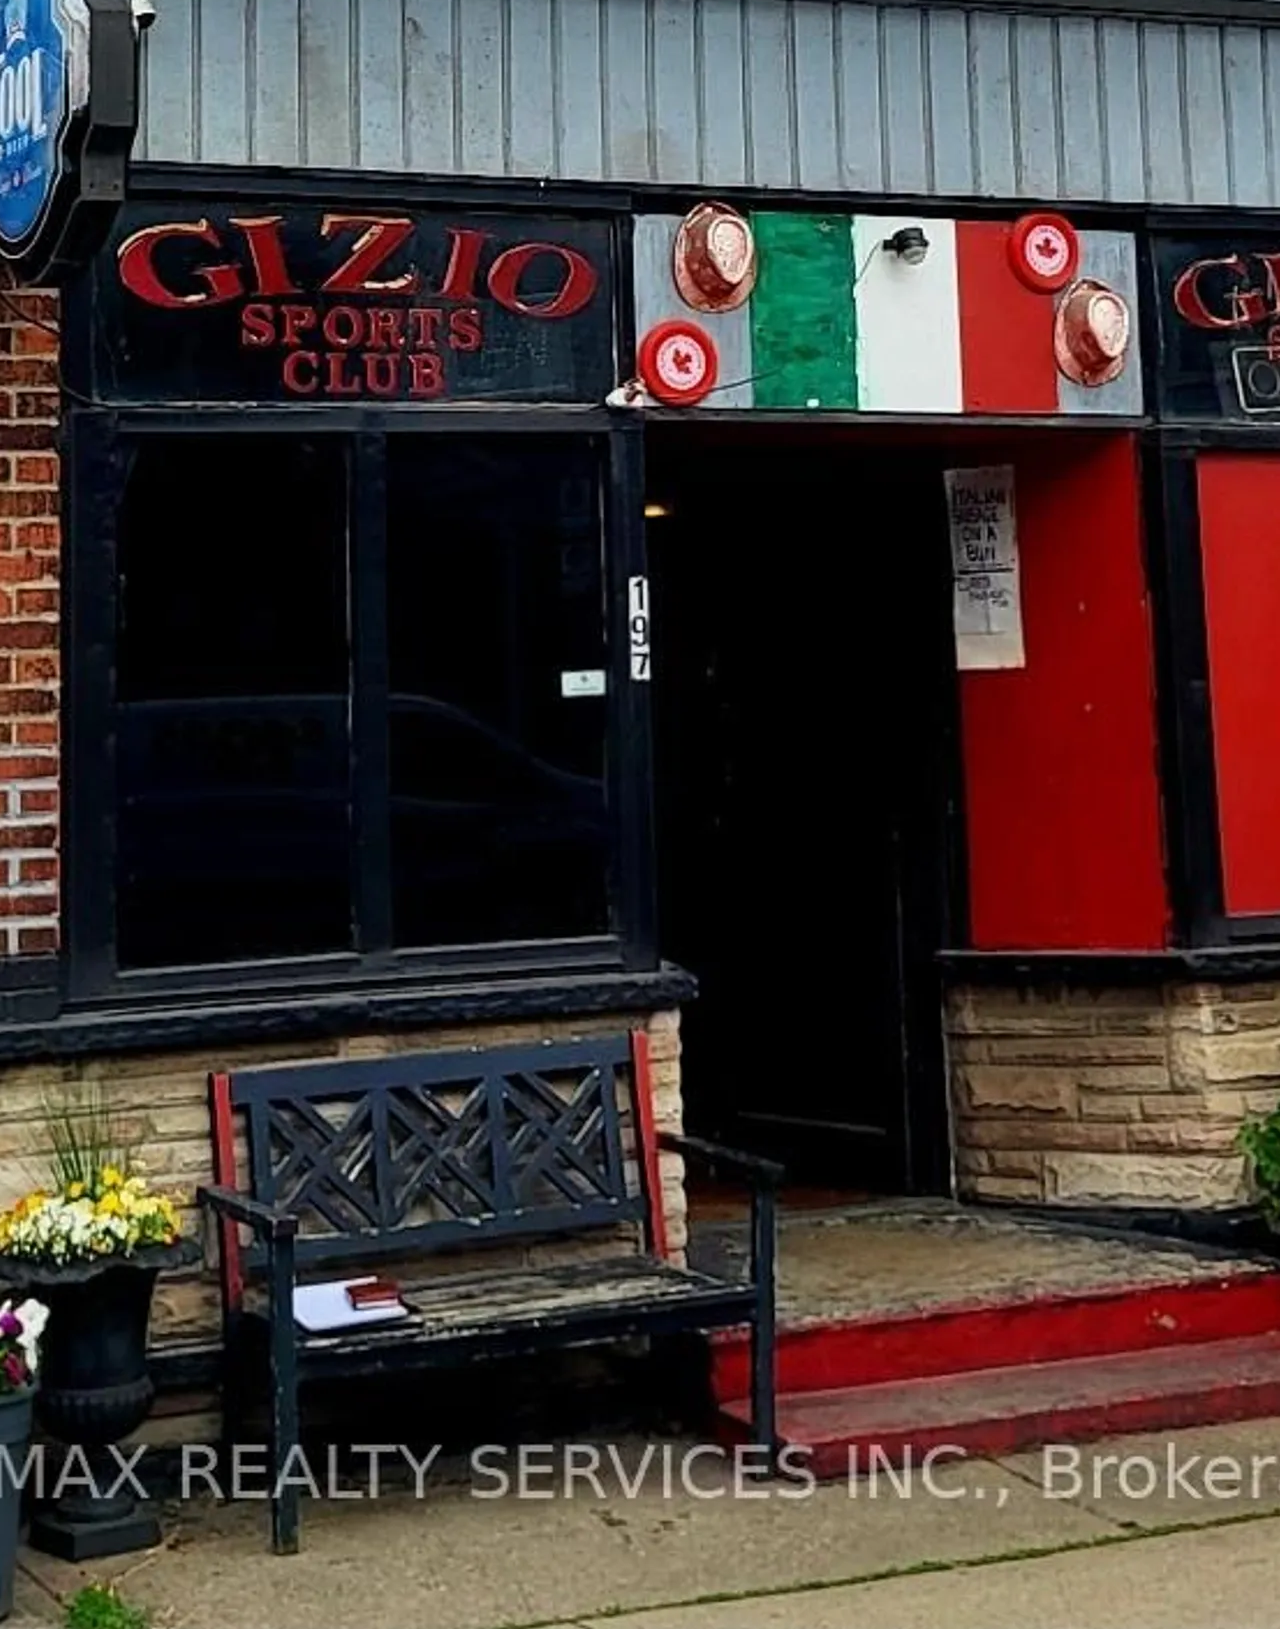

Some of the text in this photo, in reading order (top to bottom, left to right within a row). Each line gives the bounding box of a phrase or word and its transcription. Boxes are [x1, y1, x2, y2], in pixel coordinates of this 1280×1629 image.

[116, 214, 599, 319] GIZIO
[241, 303, 484, 352] SPORTS
[282, 350, 448, 398] CLUB
[631, 577, 649, 676] 197
